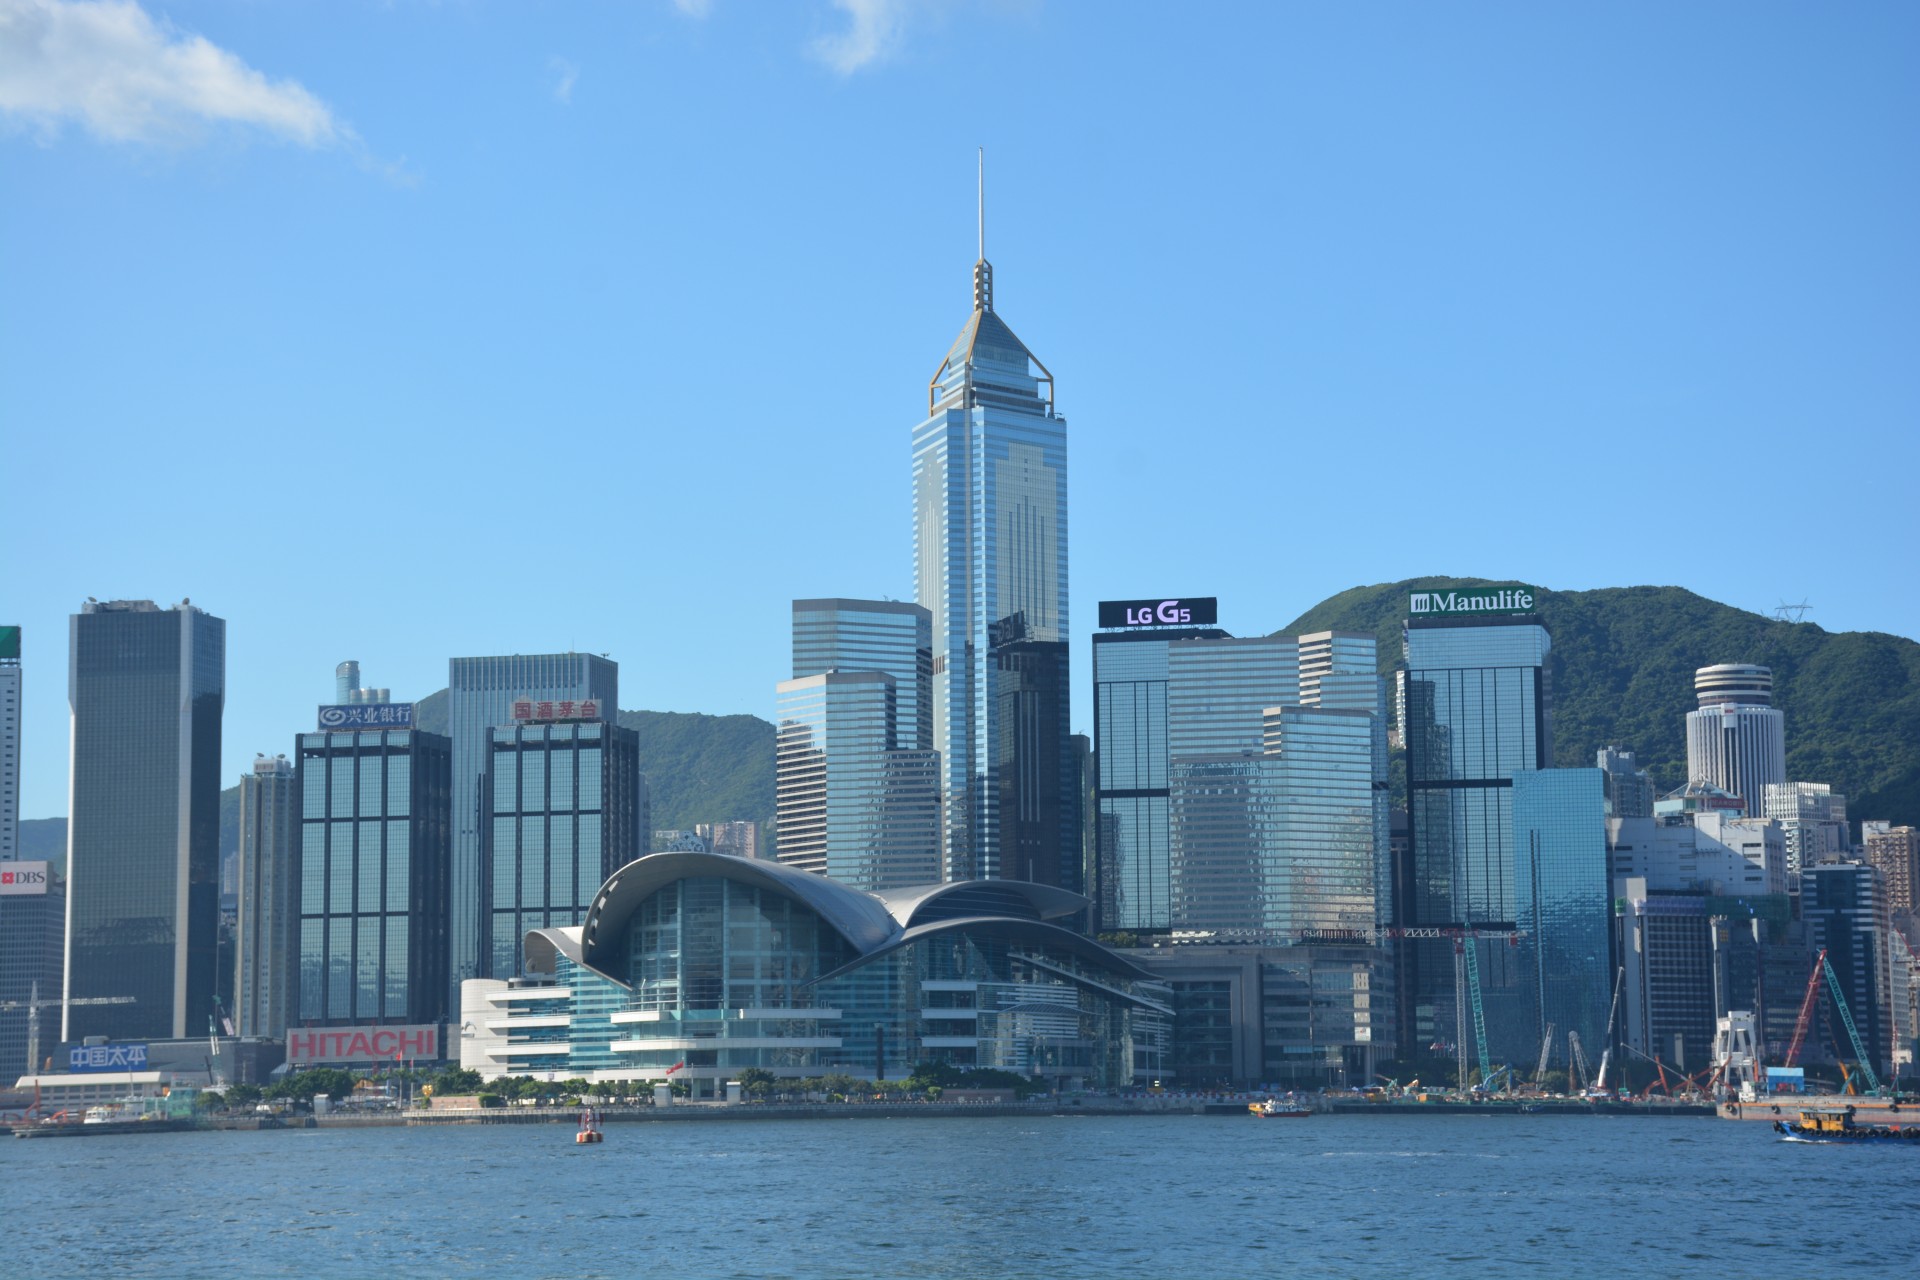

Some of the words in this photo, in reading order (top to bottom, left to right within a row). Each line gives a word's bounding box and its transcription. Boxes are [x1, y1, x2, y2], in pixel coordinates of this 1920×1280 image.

[1431, 590, 1532, 612] Manulife
[1127, 608, 1152, 624] LG
[1157, 601, 1190, 623] G5
[347, 706, 411, 723] 兴业银行
[515, 701, 596, 719] 国酒茅台
[16, 871, 45, 884] DBS
[291, 1030, 434, 1057] HITACHI
[71, 1046, 146, 1067] 中国太平
